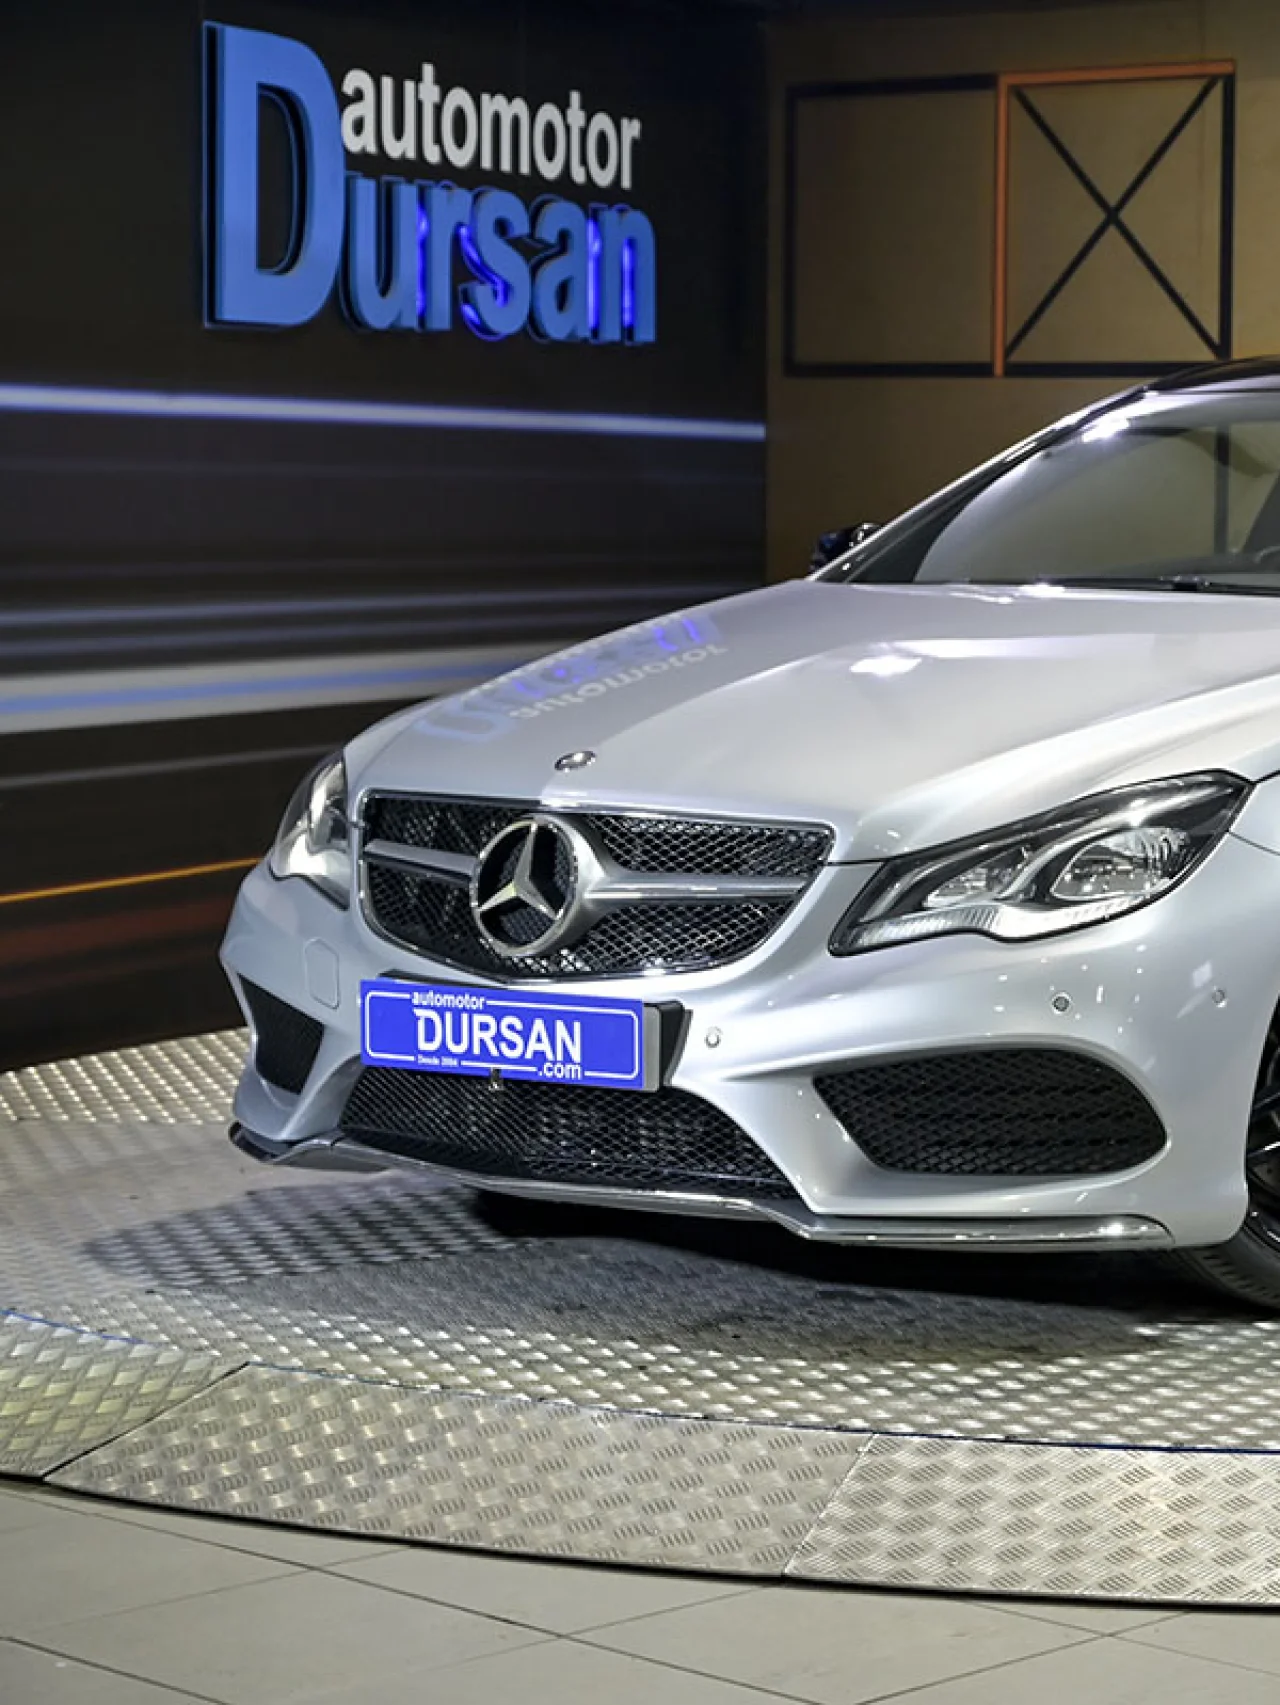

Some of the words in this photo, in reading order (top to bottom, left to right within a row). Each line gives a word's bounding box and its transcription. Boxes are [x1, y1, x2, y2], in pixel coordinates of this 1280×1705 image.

[341, 62, 642, 190] automotor
[203, 20, 656, 344] Dursan
[412, 990, 485, 1010] automotor
[413, 1008, 582, 1063] DURSAN
[538, 1061, 582, 1080] .com
